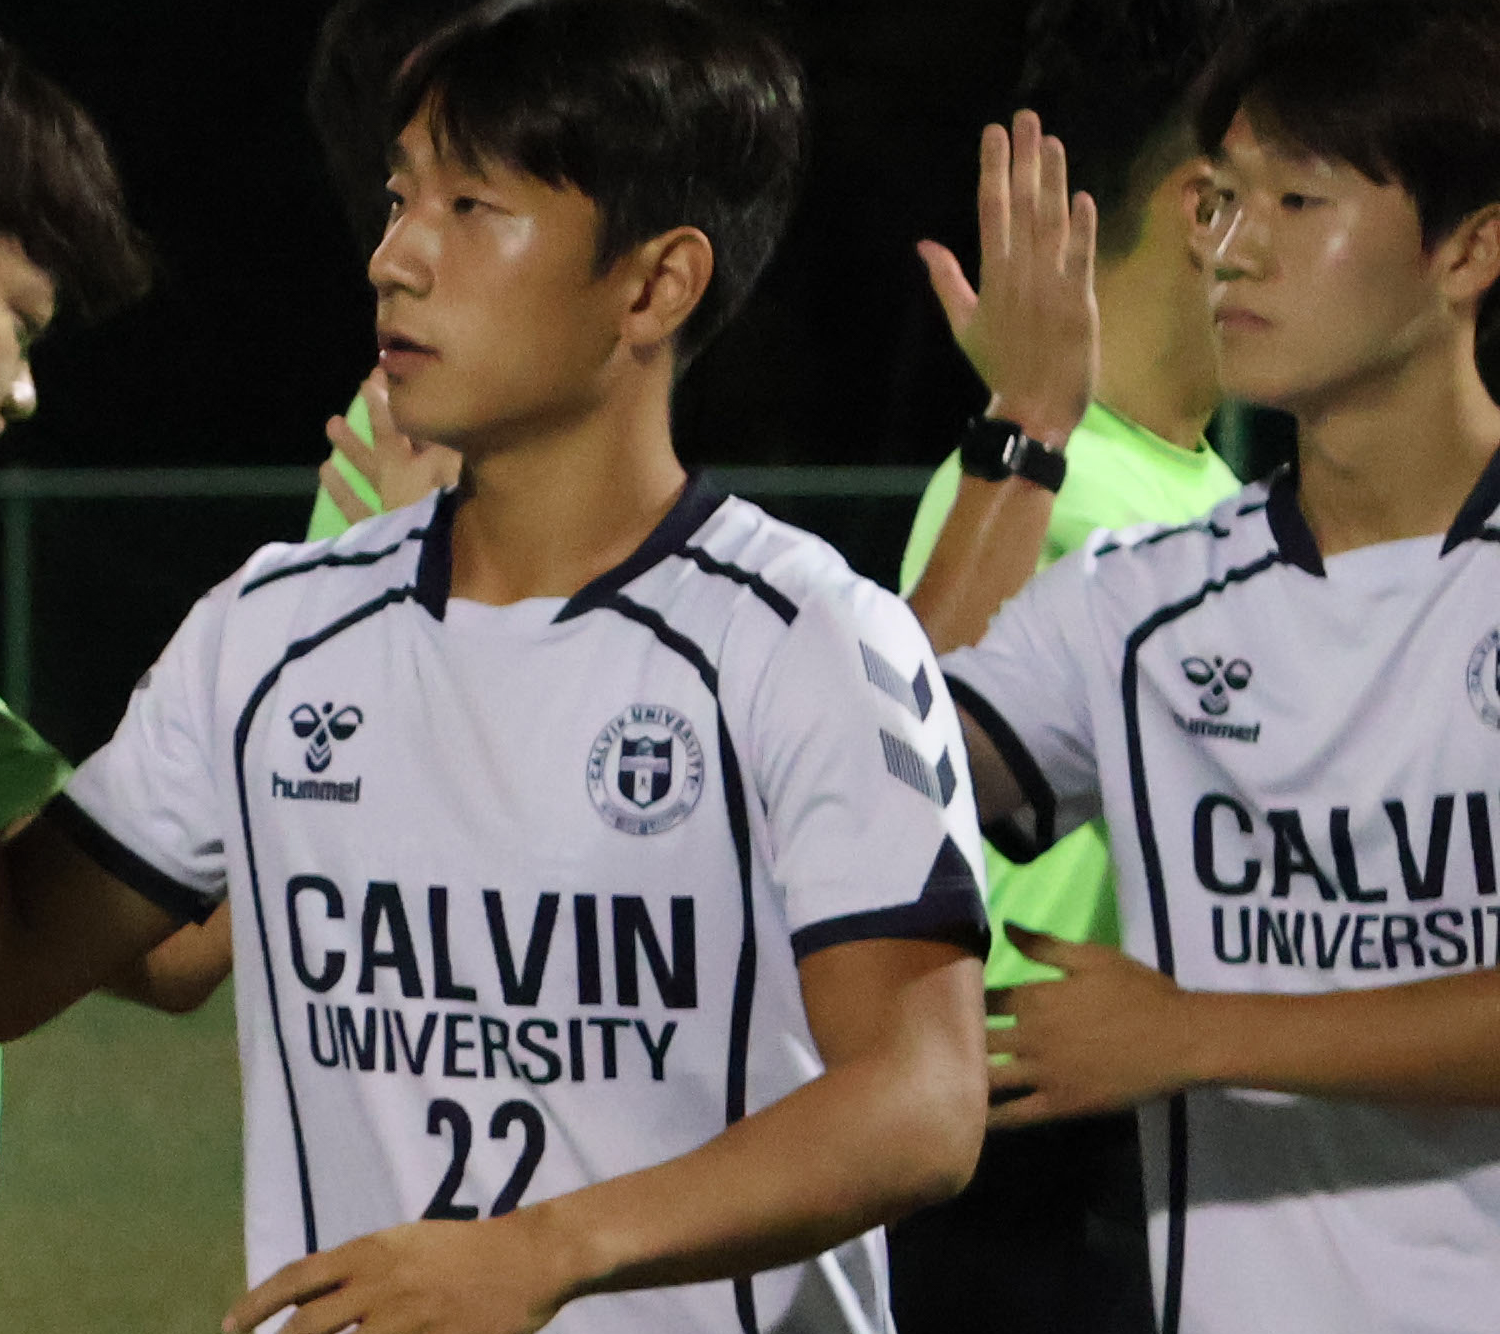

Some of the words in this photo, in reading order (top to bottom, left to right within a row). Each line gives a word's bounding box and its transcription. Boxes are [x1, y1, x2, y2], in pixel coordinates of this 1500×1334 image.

[272, 771, 362, 804] hummel
[1193, 790, 1500, 904] CALVI
[285, 874, 699, 1009] CALVIN
[307, 1002, 678, 1086] UNIVERSITY
[421, 1098, 547, 1221] 22
